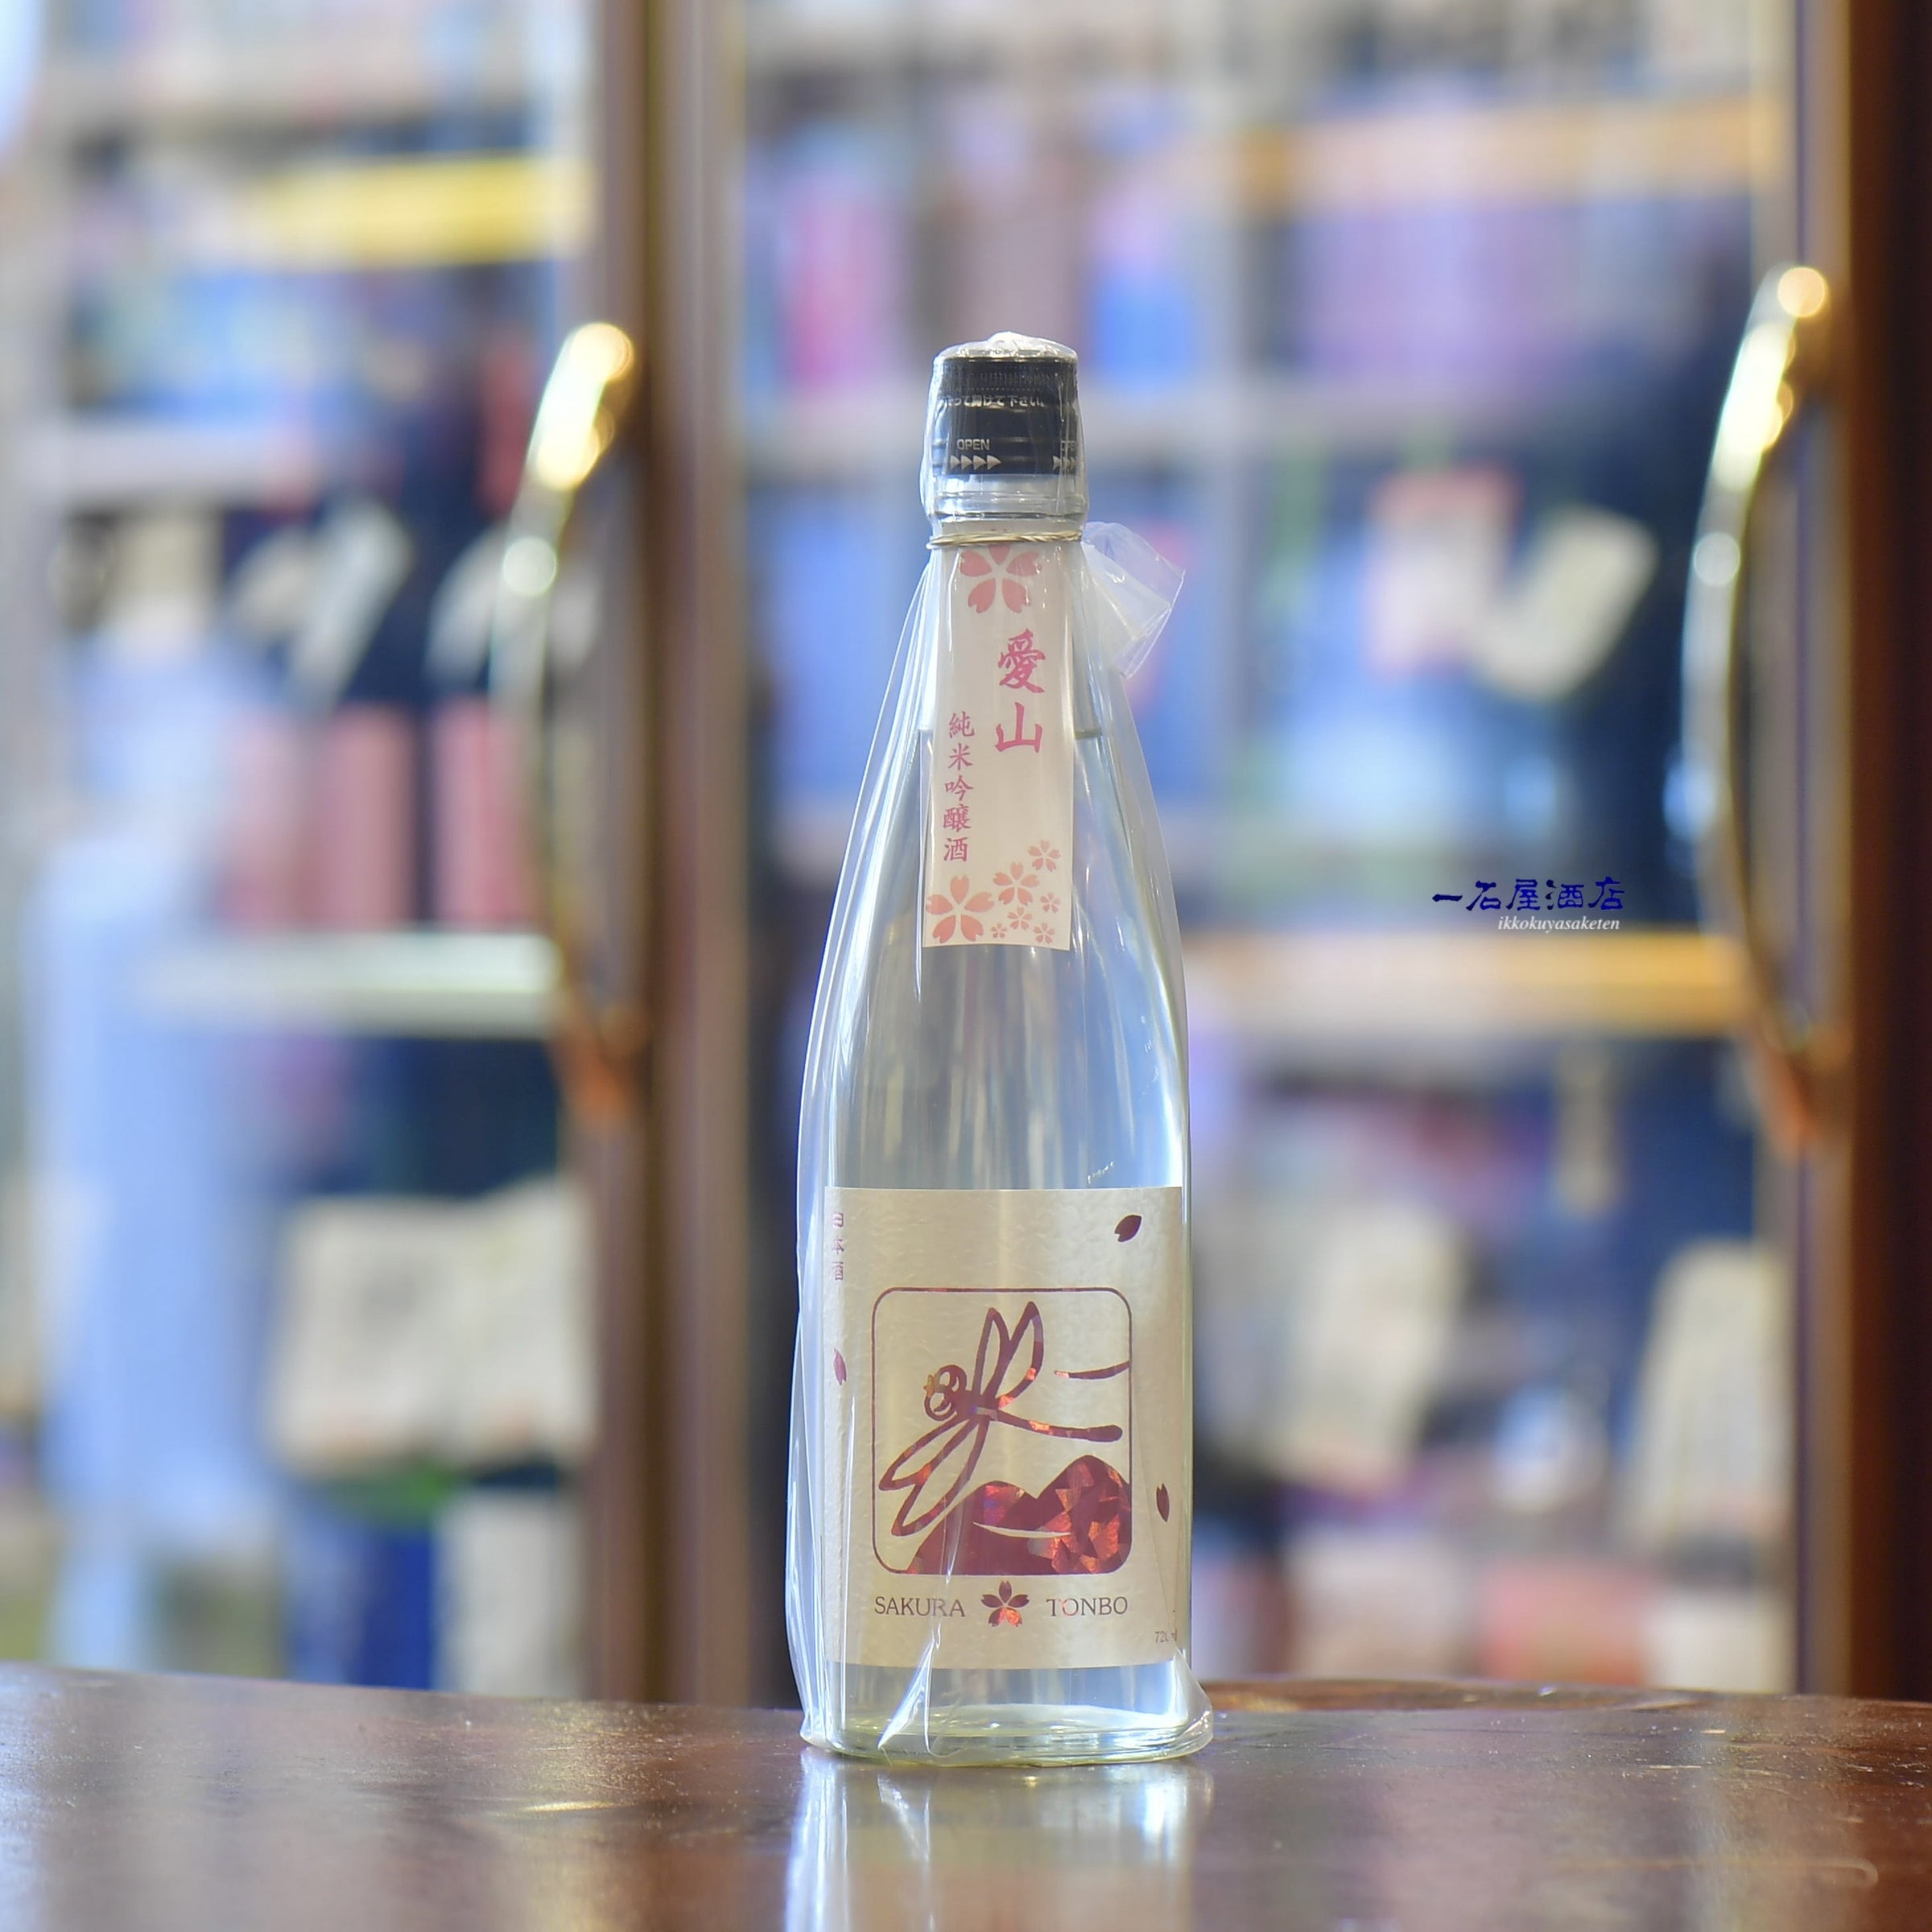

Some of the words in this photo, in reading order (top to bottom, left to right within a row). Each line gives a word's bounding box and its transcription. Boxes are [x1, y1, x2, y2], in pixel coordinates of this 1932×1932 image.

[956, 439, 990, 451] OPEN
[996, 629, 1046, 753] 愛山
[875, 1596, 965, 1617] SAKURA
[1046, 1596, 1128, 1616] TONBO
